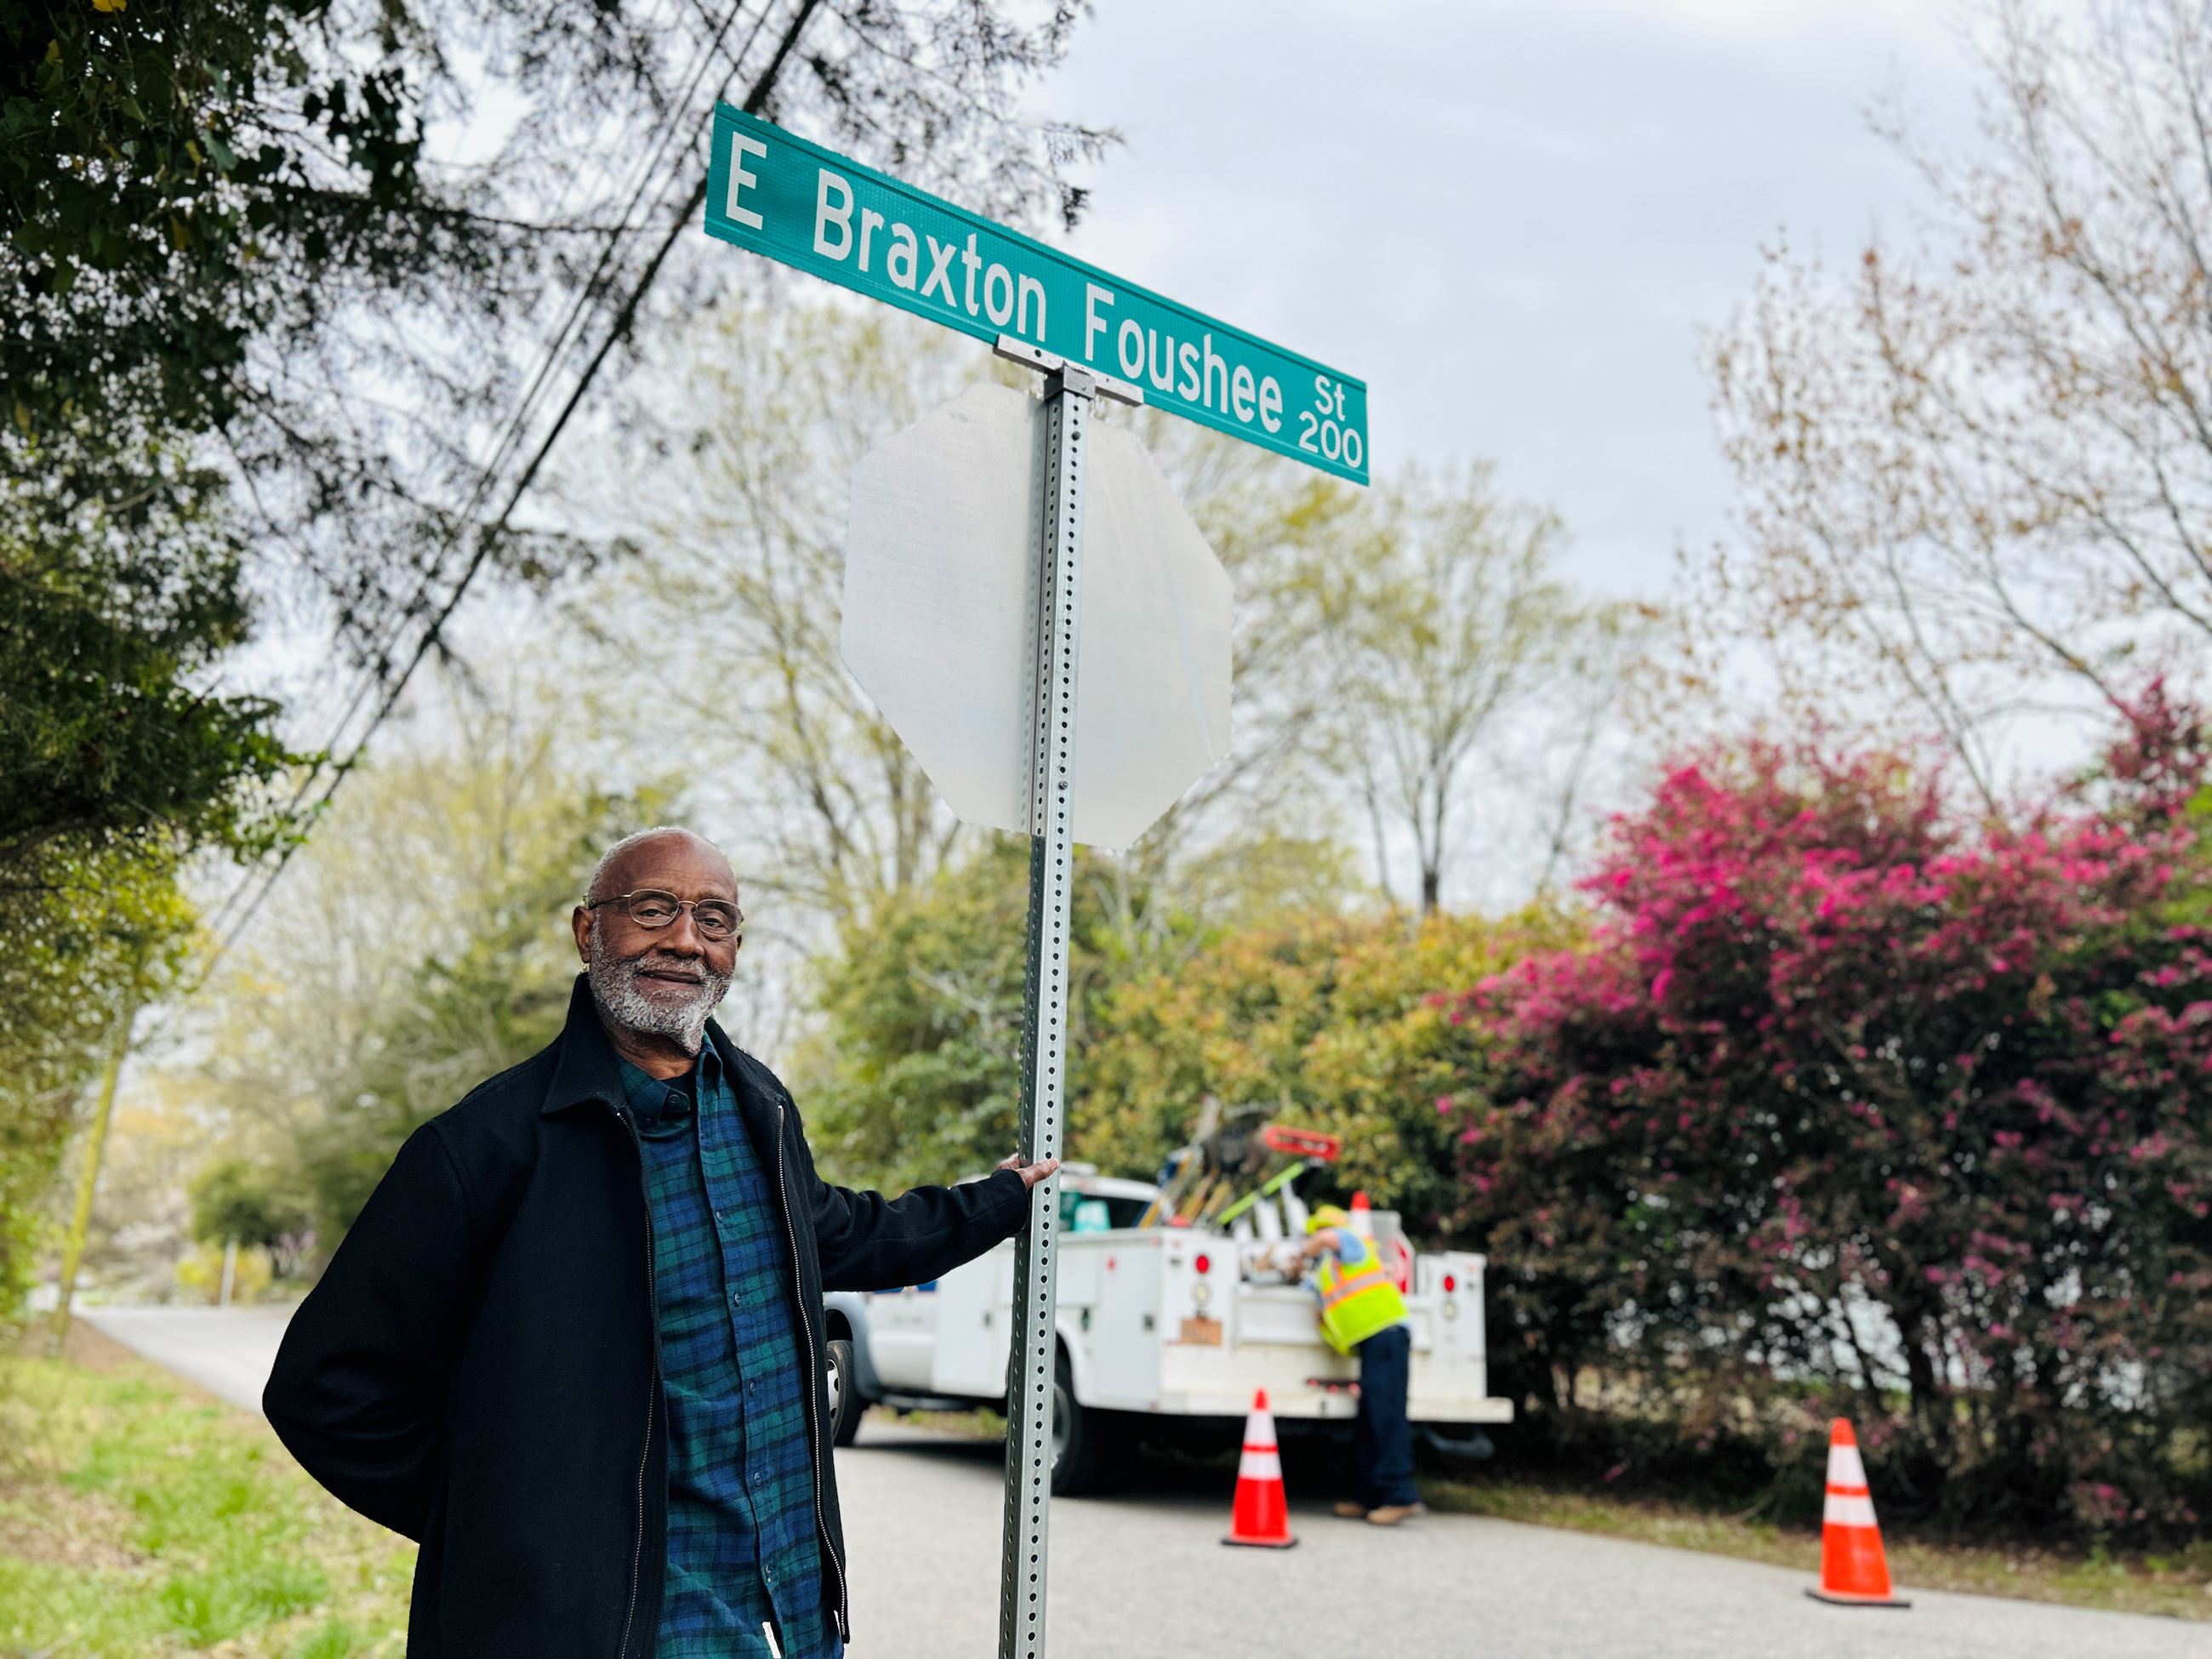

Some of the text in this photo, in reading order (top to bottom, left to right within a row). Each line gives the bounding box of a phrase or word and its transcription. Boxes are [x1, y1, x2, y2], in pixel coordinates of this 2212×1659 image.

[726, 131, 1346, 433] E Braxton Foushee St
[1299, 411, 1363, 469] 200
